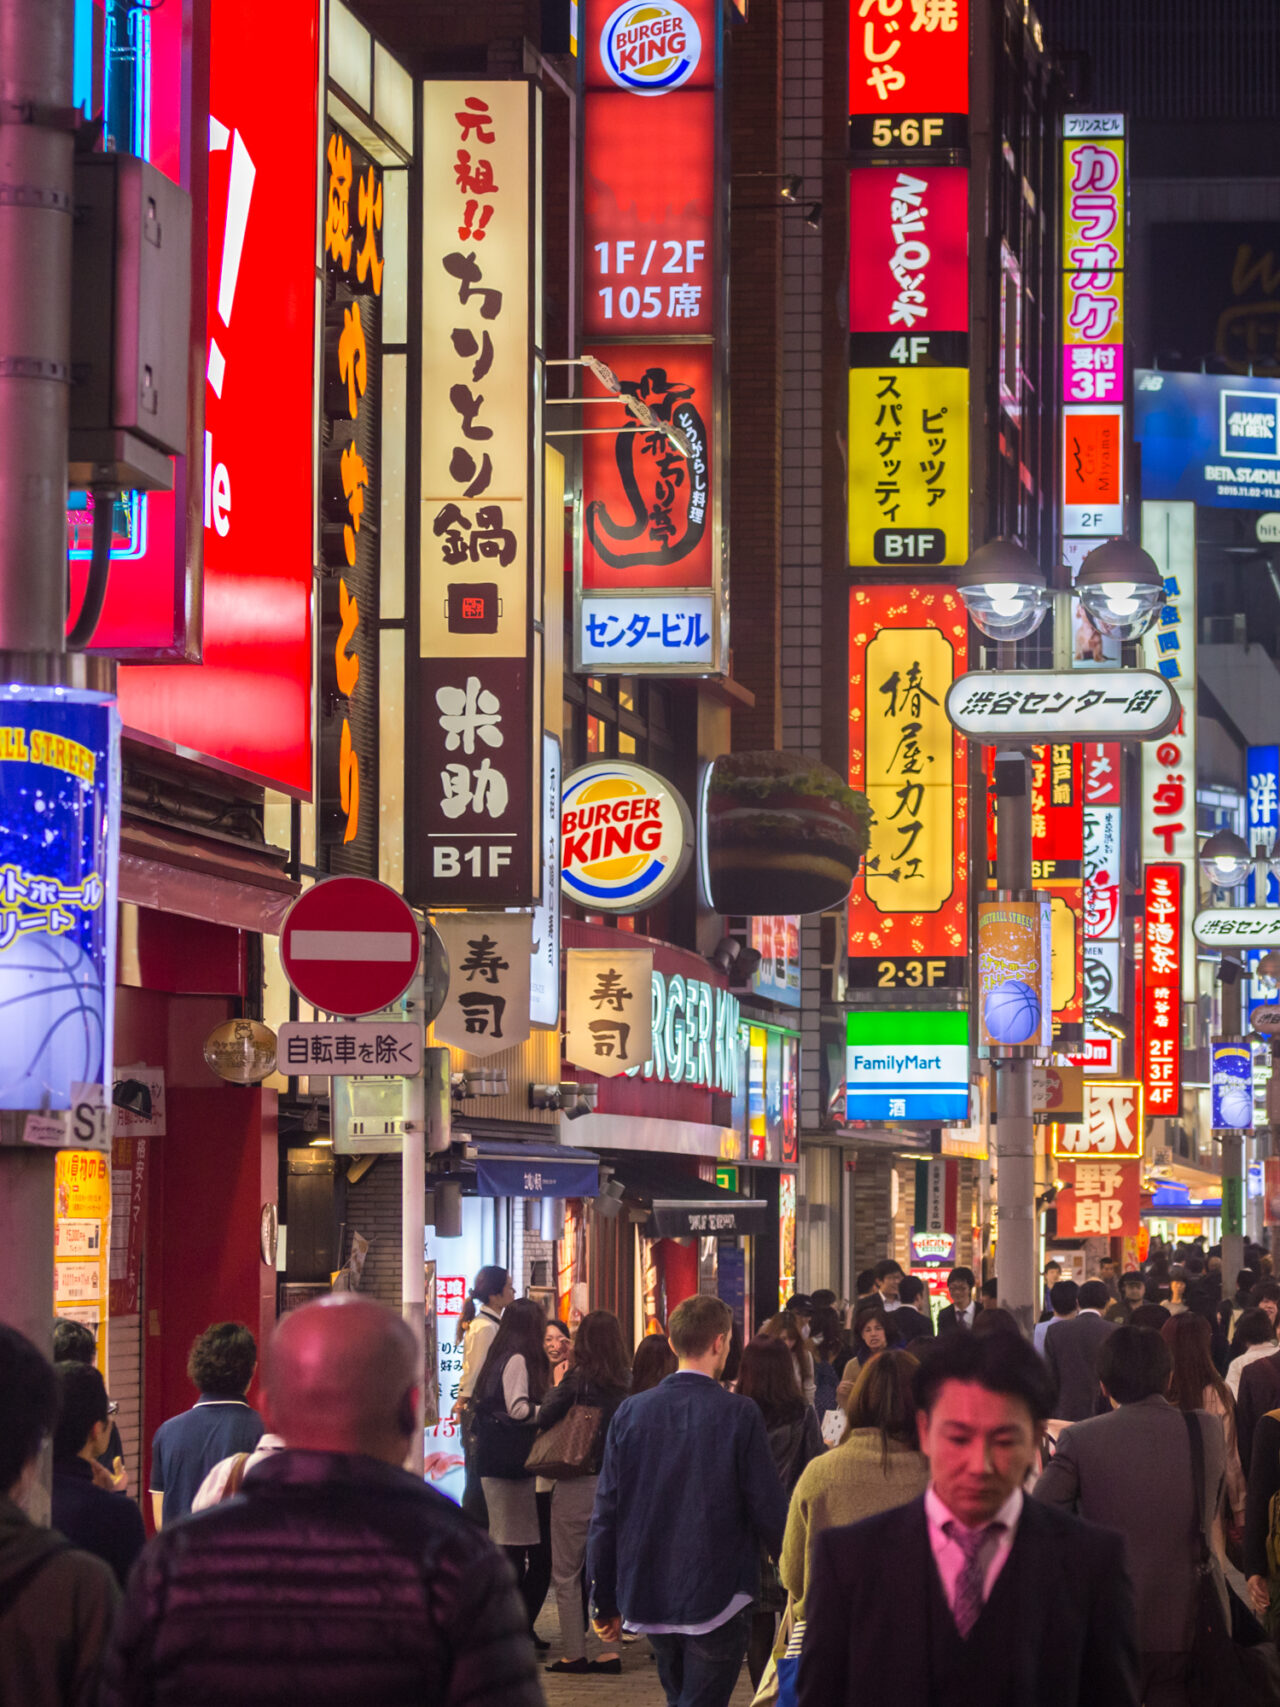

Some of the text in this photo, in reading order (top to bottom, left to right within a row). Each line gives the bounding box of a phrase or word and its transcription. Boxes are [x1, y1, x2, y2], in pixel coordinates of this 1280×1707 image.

[616, 17, 684, 49] BURGER
[618, 32, 687, 73] KING
[1069, 119, 1119, 132] プリンスビル
[1068, 145, 1119, 341] カラオケ
[597, 282, 702, 319] 105席
[890, 337, 931, 364] 4F
[1071, 348, 1116, 370] 受付
[1071, 372, 1116, 399] 3F
[1227, 413, 1275, 427] ALWAYS
[1231, 426, 1273, 438] IN BETA
[875, 375, 903, 522] スパゲッティ
[920, 407, 948, 507] ピッツァ
[1205, 466, 1237, 483] BETA
[1081, 514, 1104, 527] 2F
[884, 534, 935, 558] B1F
[586, 612, 711, 649] センタービル
[959, 688, 1162, 716] 渋谷センター街
[435, 676, 508, 819] 米助
[880, 661, 940, 881] 椿屋カフェ
[1052, 744, 1072, 804] 江戸前
[562, 798, 661, 834] BURGER
[562, 820, 663, 868] KING
[433, 847, 512, 878] B1F
[459, 934, 510, 1040] 寿司
[588, 967, 634, 1060] 寿司
[1153, 986, 1170, 1028] 渋谷店
[287, 1033, 413, 1067] 自転車を除く
[853, 1053, 942, 1074] FamilyMart
[1150, 1039, 1174, 1057] 2F
[1150, 1063, 1174, 1080] 3F
[889, 1099, 906, 1117] 酒
[1150, 1088, 1174, 1104] 4F
[1062, 1086, 1135, 1153] 豚
[1072, 1163, 1124, 1235] 野郎
